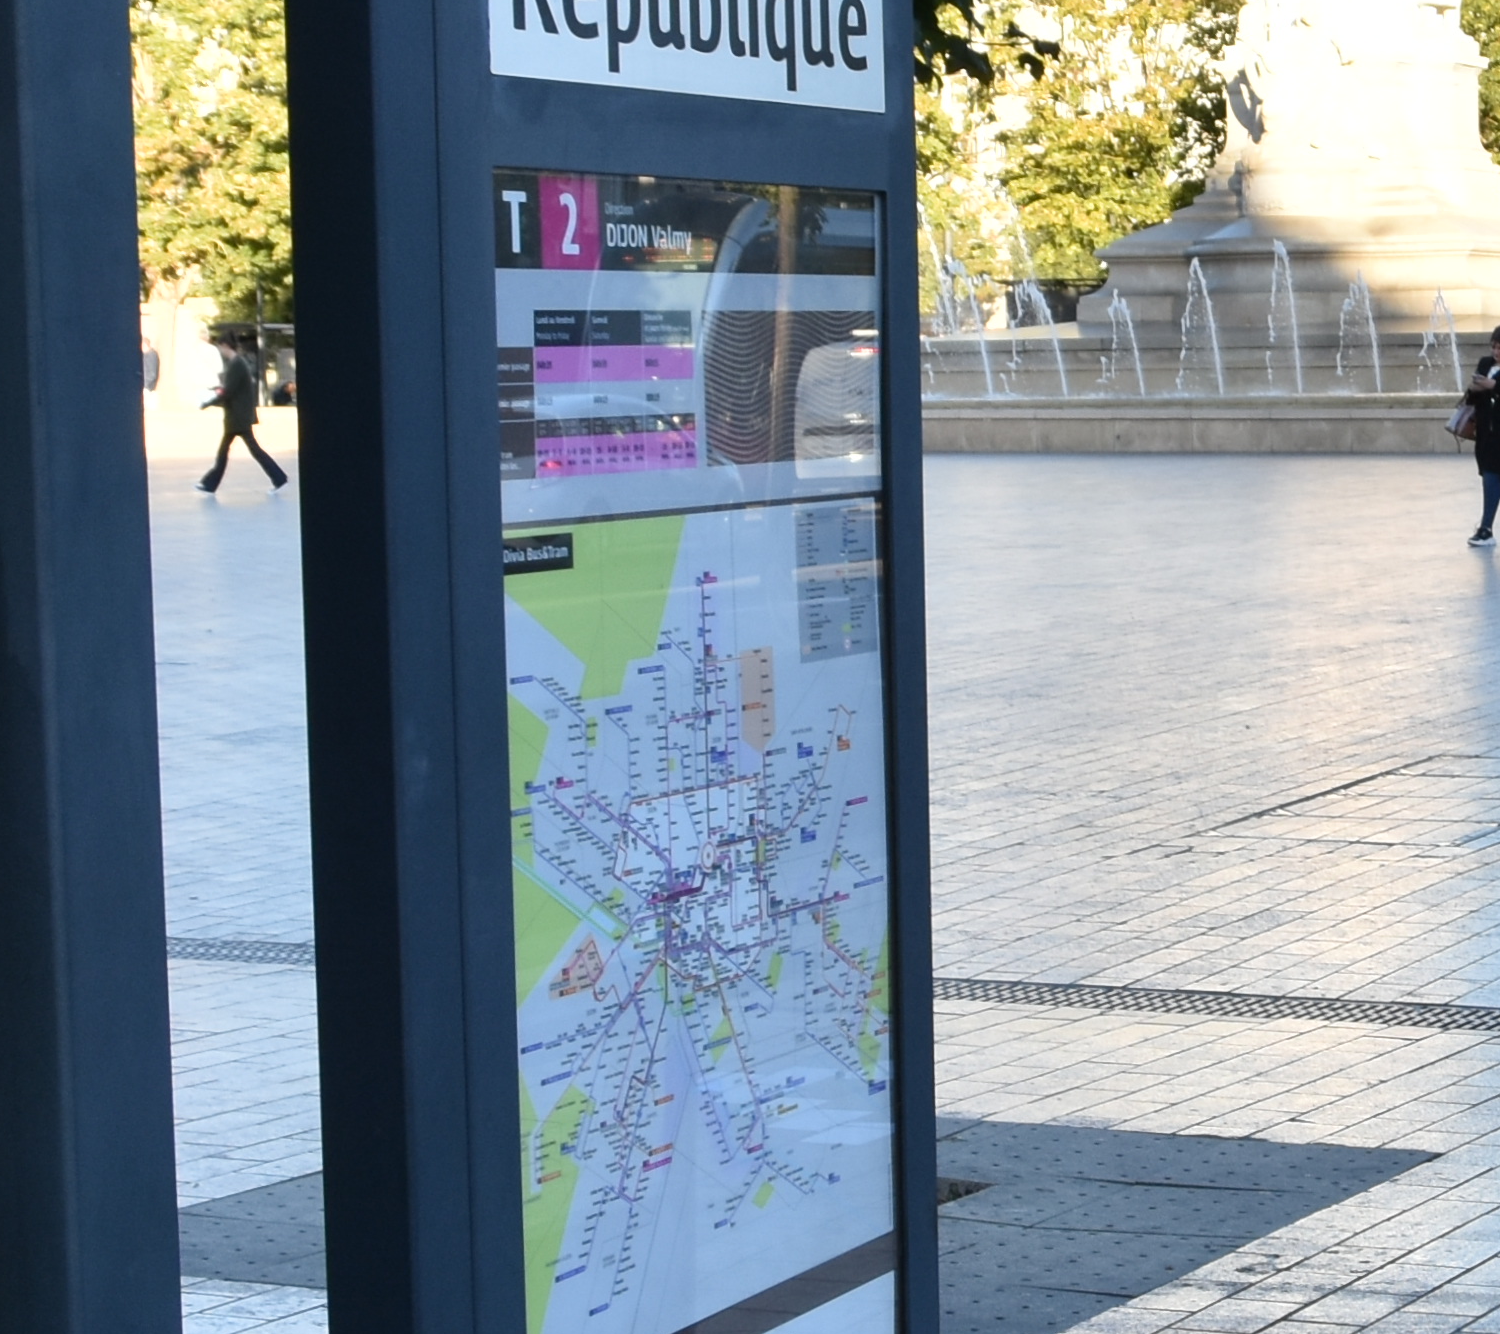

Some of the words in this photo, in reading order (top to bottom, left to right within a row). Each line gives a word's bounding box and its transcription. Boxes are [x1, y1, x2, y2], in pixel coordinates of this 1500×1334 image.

[502, 190, 527, 254] T
[559, 193, 580, 255] 2
[606, 223, 648, 248] DIJON
[651, 225, 692, 255] Valmy
[503, 547, 524, 563] Divia
[527, 544, 568, 561] Bus&Tram
